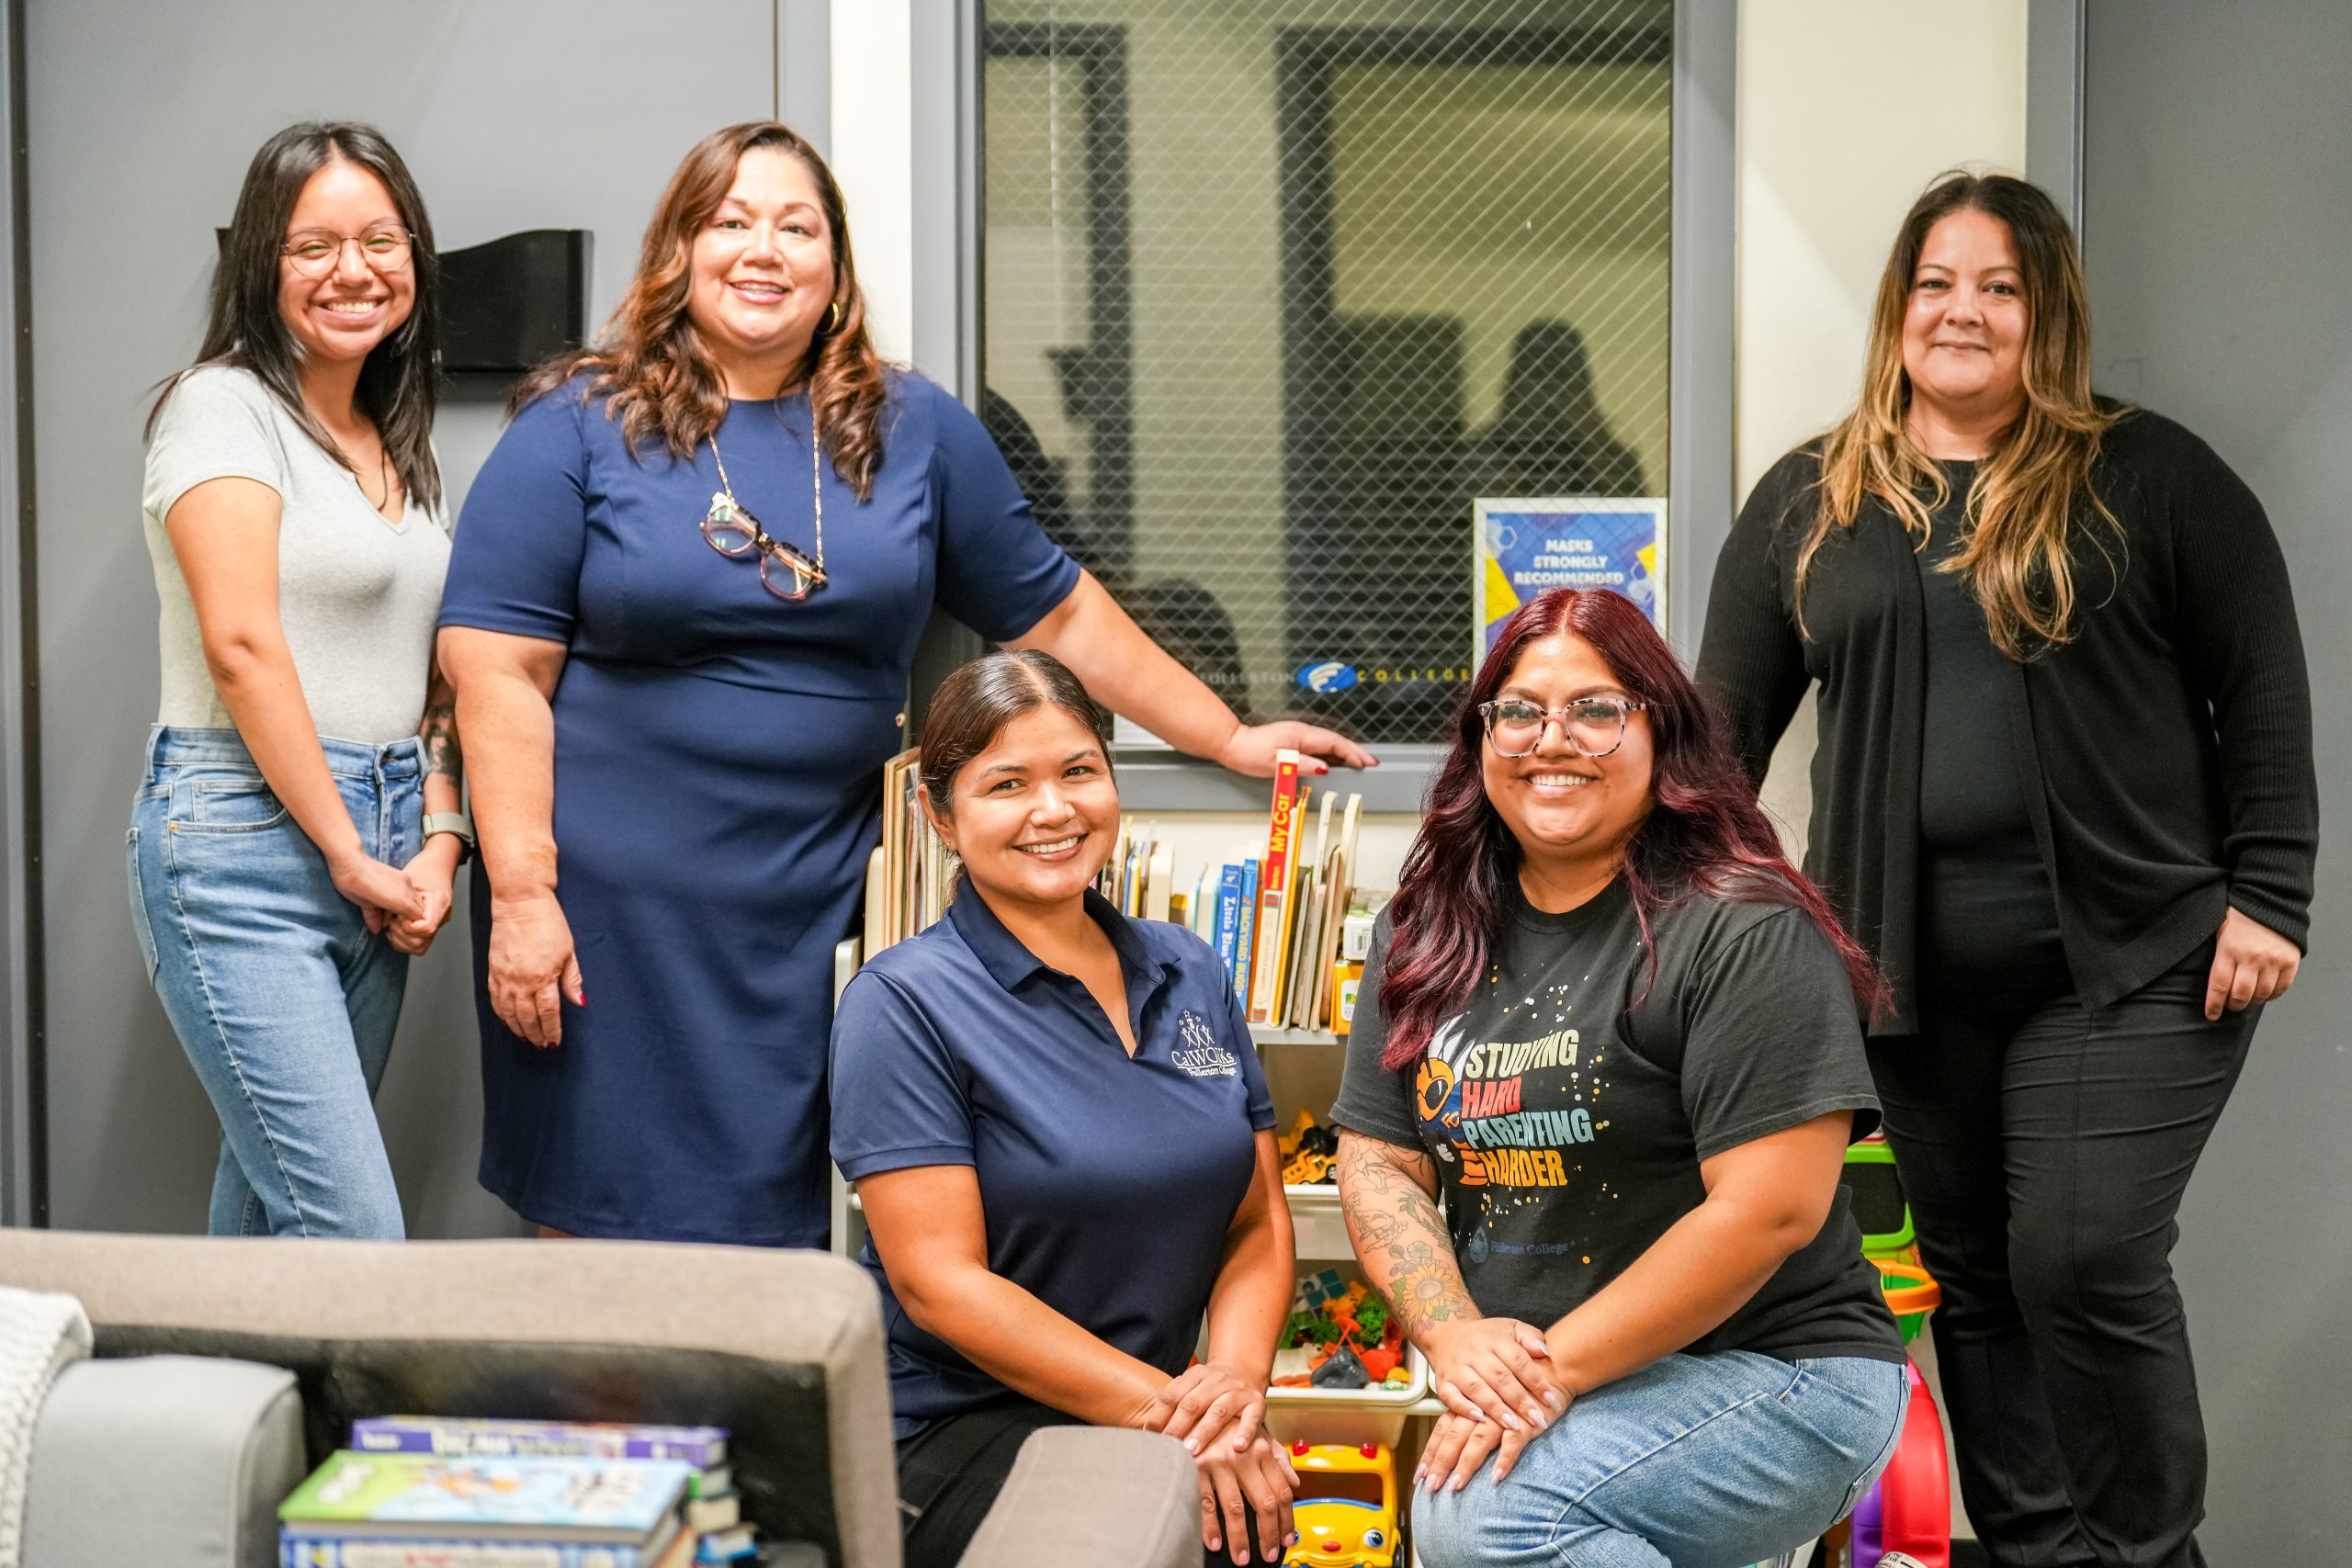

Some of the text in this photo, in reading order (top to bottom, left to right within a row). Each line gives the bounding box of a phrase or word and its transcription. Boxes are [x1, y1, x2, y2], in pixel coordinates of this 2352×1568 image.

[1545, 539, 1593, 552] MASKS
[1514, 571, 1624, 585] RECOMMENDED
[1533, 555, 1608, 569] STRONGLY
[1273, 793, 1290, 825] Car
[1270, 828, 1288, 852] My
[1223, 896, 1236, 930] Little
[1221, 932, 1233, 957] Blue
[1238, 907, 1251, 961] BACKYARD
[1464, 1030, 1579, 1078] STUDYING
[1461, 1077, 1522, 1118] HARD
[1462, 1108, 1595, 1148] PARENTING
[1477, 1148, 1567, 1187] HARDER
[1526, 1242, 1569, 1255] College
